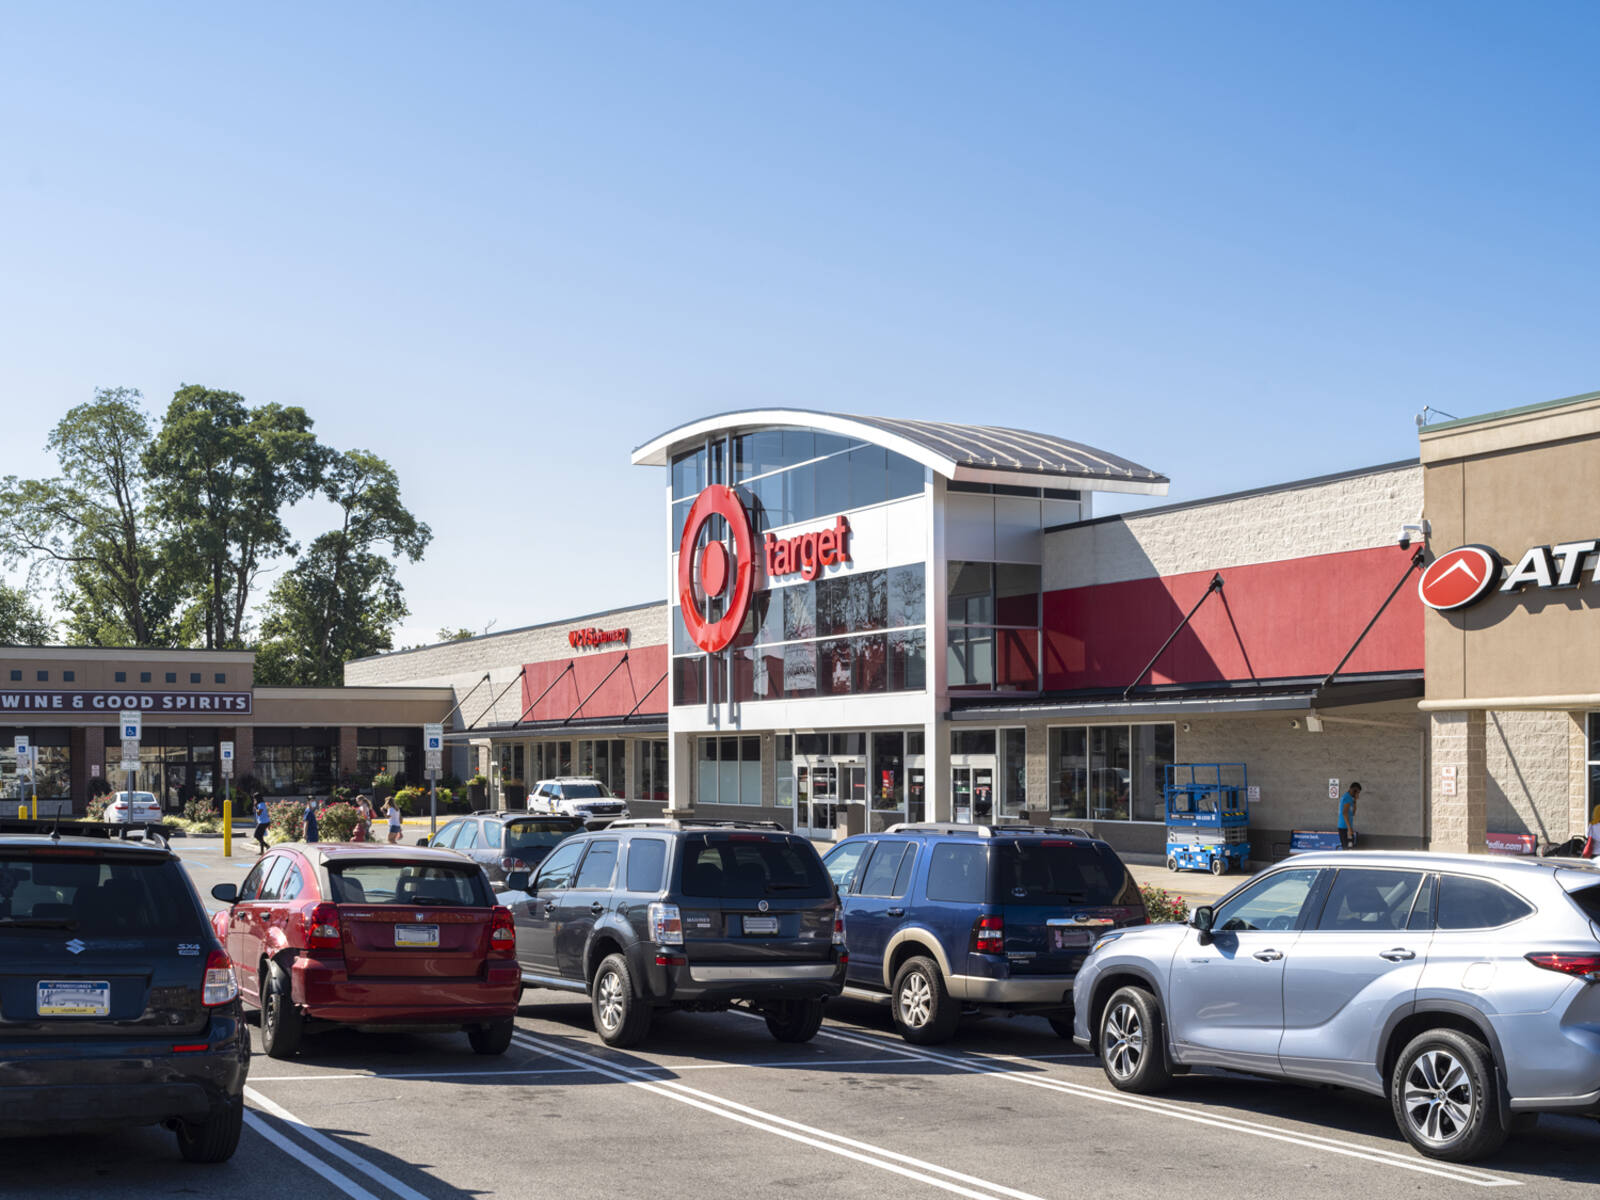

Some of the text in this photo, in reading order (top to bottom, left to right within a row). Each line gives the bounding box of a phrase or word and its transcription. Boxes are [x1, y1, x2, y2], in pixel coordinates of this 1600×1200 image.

[764, 515, 851, 581] target
[1, 695, 246, 709] WINE & GOOD SPIRITS
